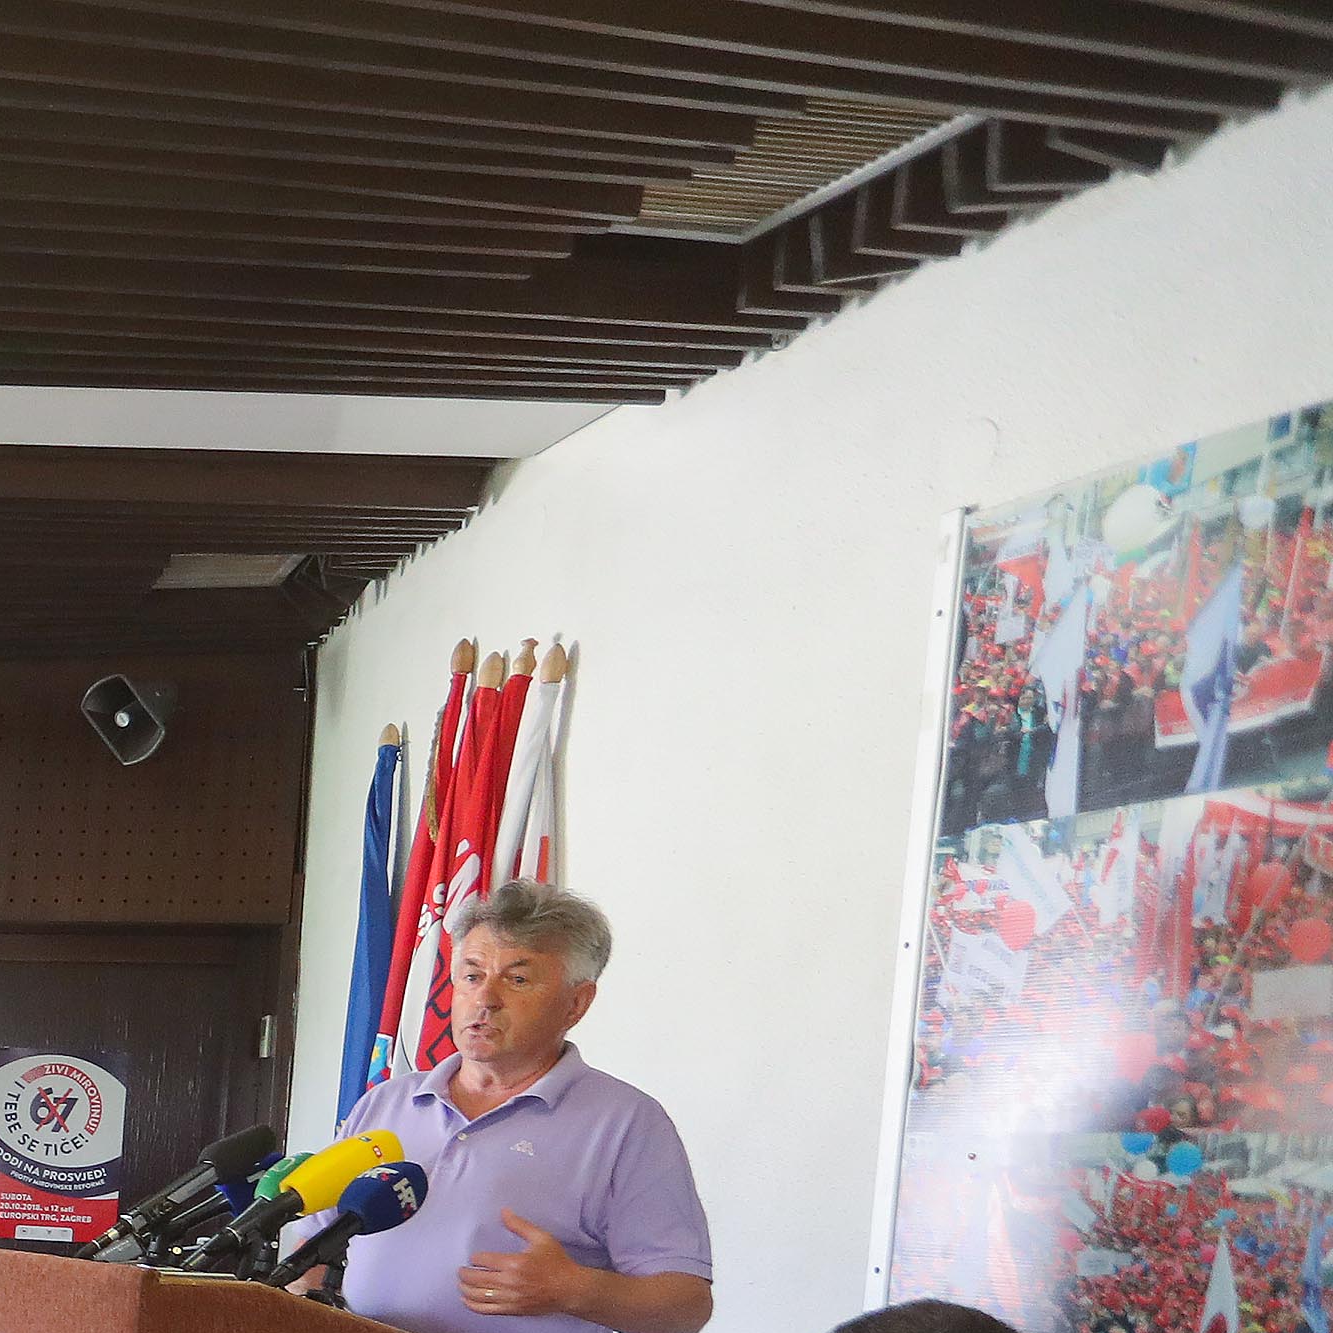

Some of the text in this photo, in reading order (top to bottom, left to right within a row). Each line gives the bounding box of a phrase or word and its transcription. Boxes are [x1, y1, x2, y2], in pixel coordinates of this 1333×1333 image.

[70, 1069, 102, 1133] MIROVINU!
[4, 1080, 89, 1156] I TEBE SE TIČE!
[24, 1163, 40, 1177] NA
[42, 1167, 108, 1182] PROSVJED!
[73, 1179, 106, 1191] REFORME
[50, 1204, 59, 1212] 12
[0, 1211, 39, 1221] EUROPSKI
[60, 1214, 93, 1224] ZAGREB
